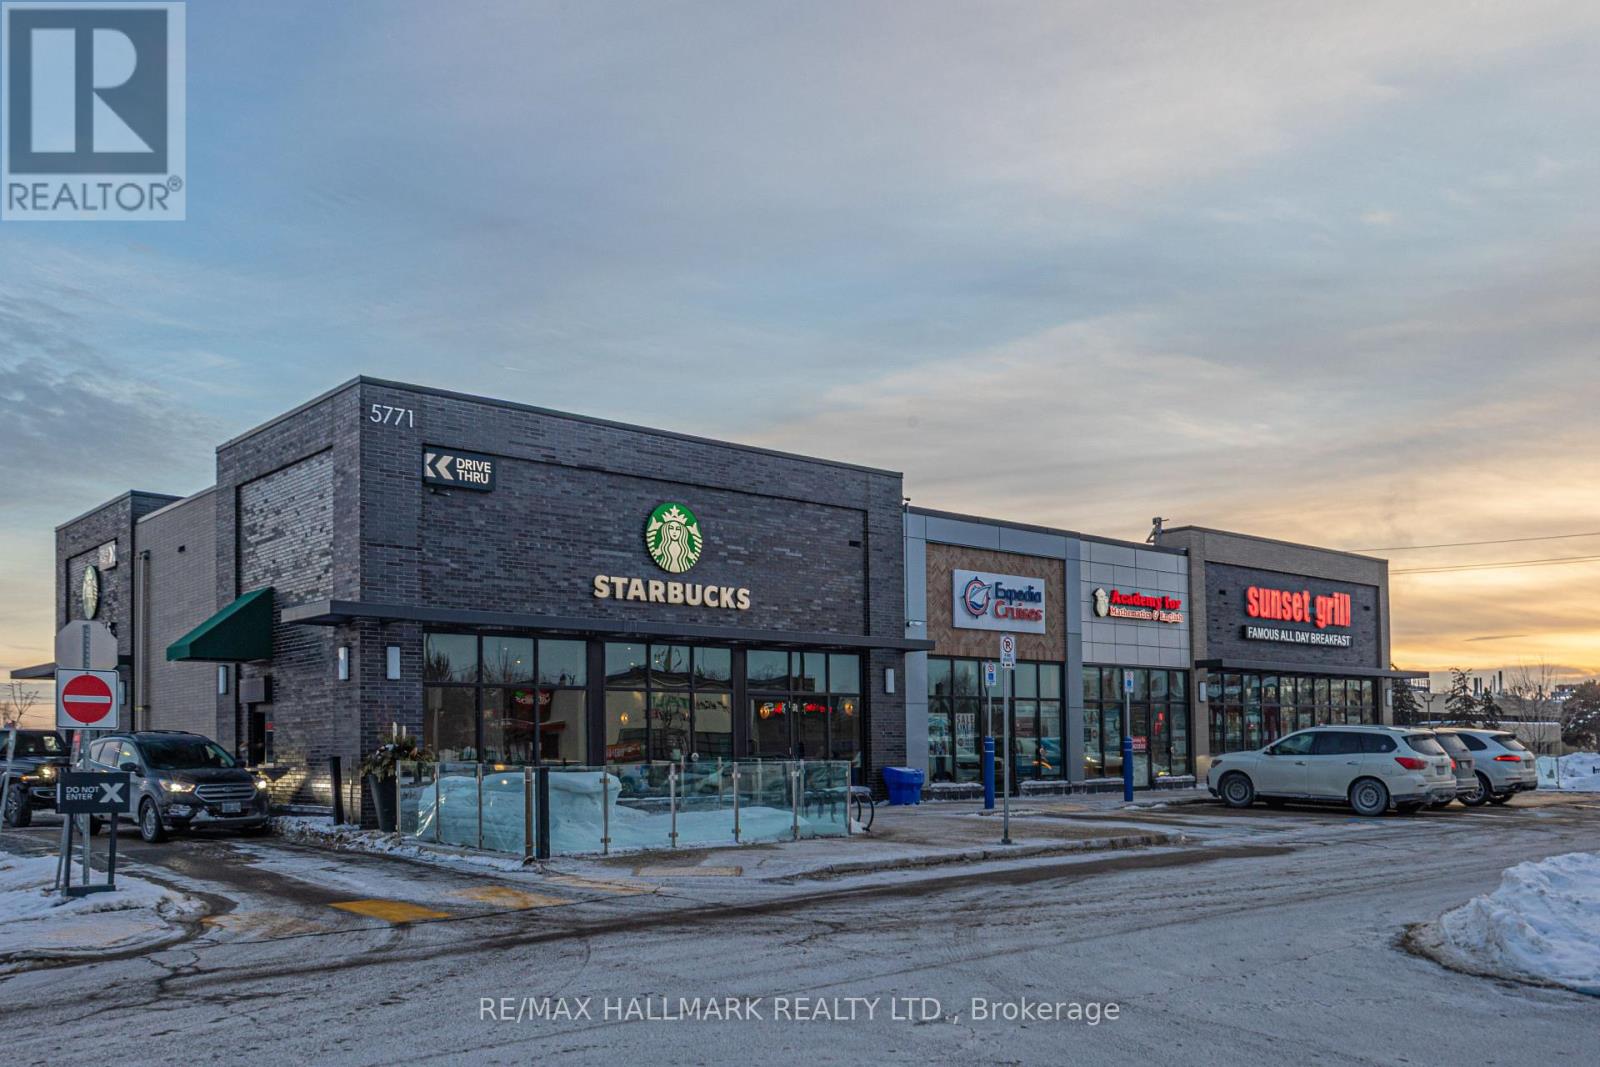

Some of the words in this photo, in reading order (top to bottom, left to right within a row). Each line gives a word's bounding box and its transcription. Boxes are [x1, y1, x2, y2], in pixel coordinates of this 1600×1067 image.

[370, 403, 414, 428] 5771
[456, 458, 492, 473] DRIVE
[456, 469, 489, 484] THRU
[593, 574, 751, 611] STARBUCKS
[995, 581, 1042, 606] Expedia
[1110, 590, 1162, 611] Academy
[1163, 595, 1182, 610] for
[994, 599, 1043, 622] Cruises
[1110, 606, 1152, 620] Mathematics
[1247, 586, 1311, 623] sunset
[1314, 591, 1351, 629] grill
[1247, 626, 1280, 641] FAMOUS
[1280, 630, 1295, 642] ALL
[1295, 631, 1310, 644] DAY
[1310, 633, 1350, 646] BREAKFAST
